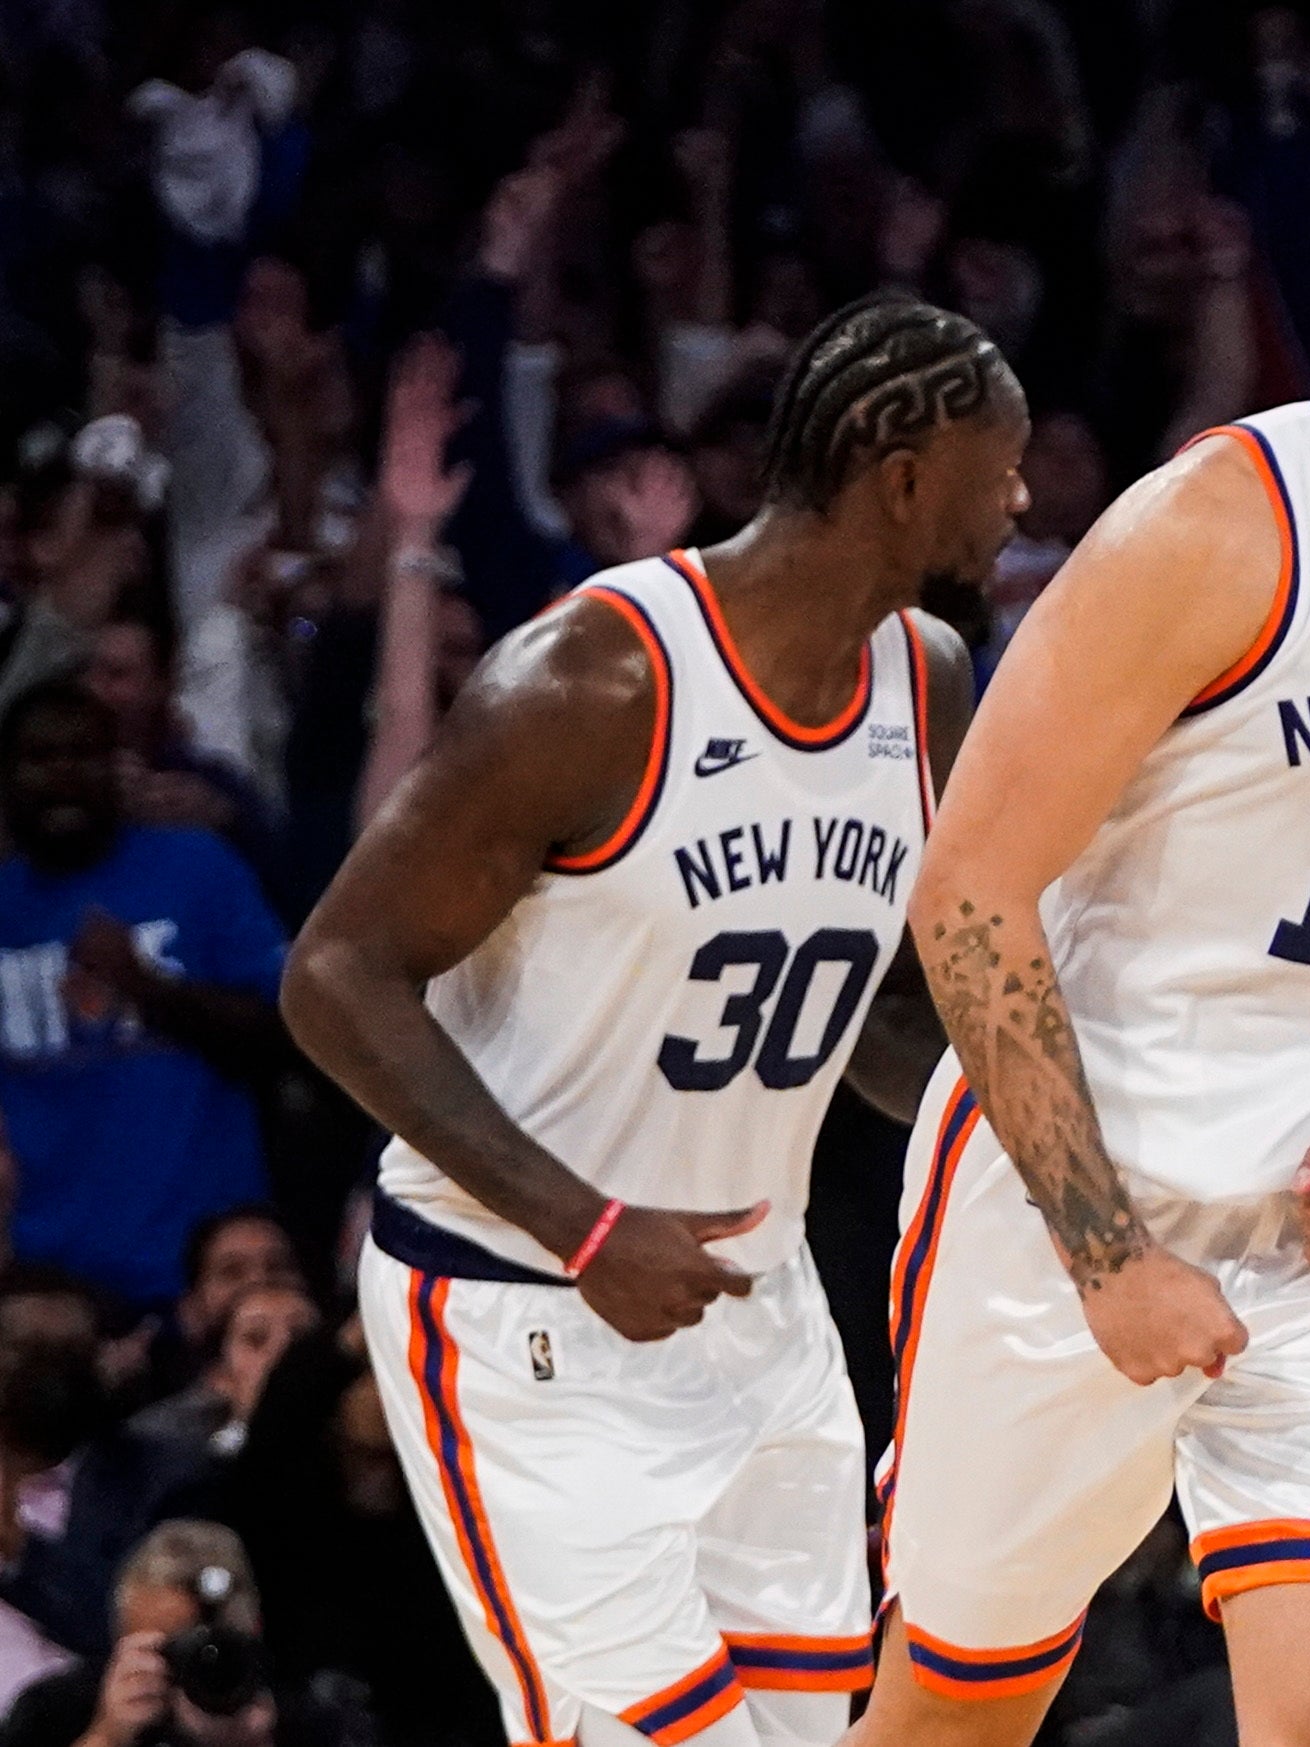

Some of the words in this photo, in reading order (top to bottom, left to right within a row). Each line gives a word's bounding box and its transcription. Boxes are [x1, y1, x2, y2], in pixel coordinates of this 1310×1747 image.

[674, 819, 791, 908] NEW
[814, 817, 908, 906] YORK
[657, 928, 879, 1091] 30
